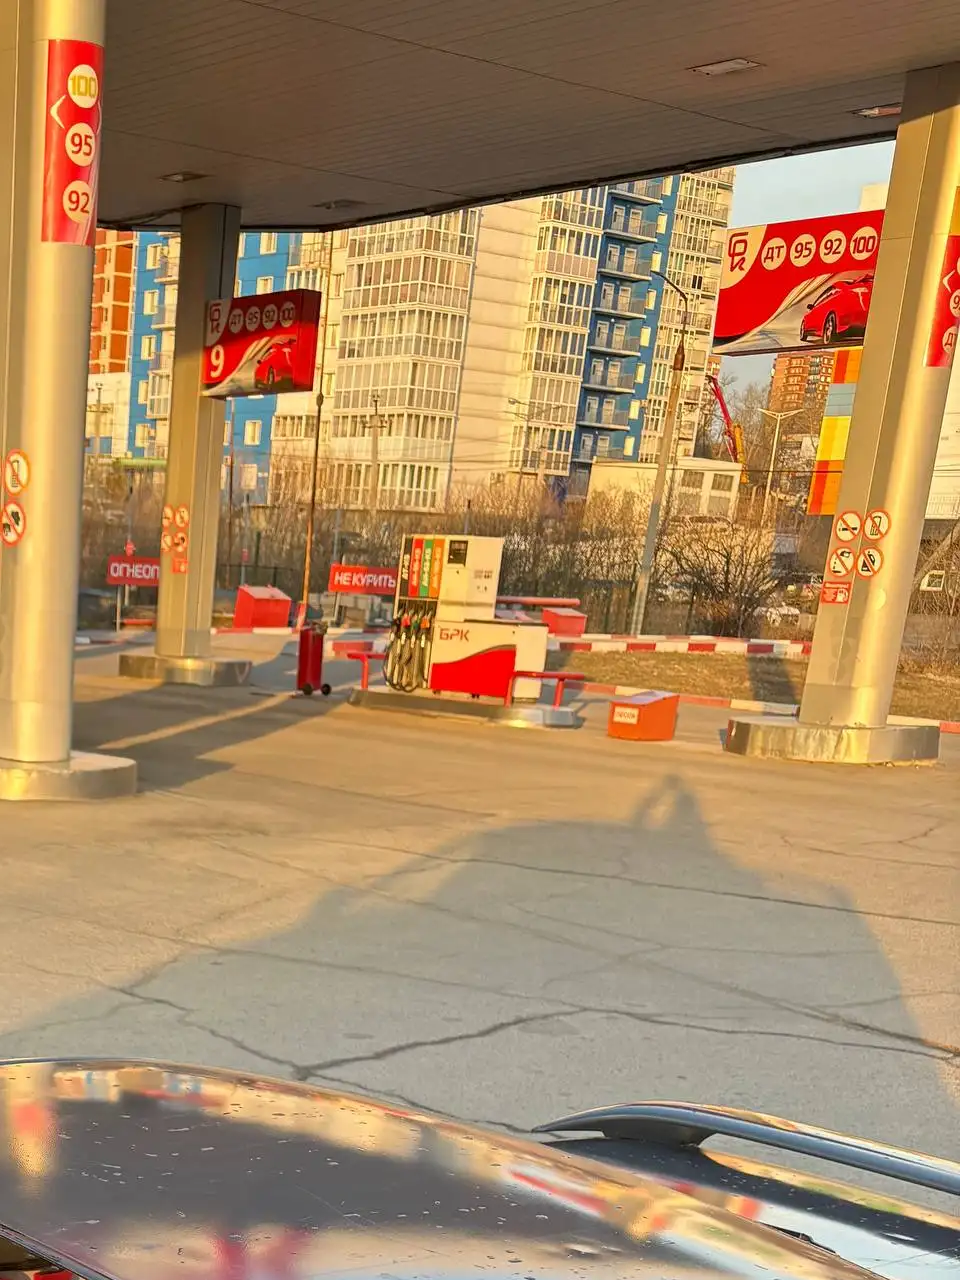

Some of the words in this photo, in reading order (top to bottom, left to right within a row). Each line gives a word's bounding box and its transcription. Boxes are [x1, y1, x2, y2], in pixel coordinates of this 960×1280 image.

[70, 75, 97, 97] 100
[71, 133, 92, 156] 95
[68, 191, 89, 213] 92
[764, 245, 784, 263] ДТ
[794, 242, 813, 259] 95
[824, 238, 842, 256] 92
[852, 236, 875, 254] 100
[248, 311, 259, 325] 95
[265, 308, 276, 322] 92
[211, 345, 224, 378] 9
[334, 571, 351, 585] НЕ
[352, 574, 396, 589] КУРИТЬ
[440, 628, 470, 642] БРК
